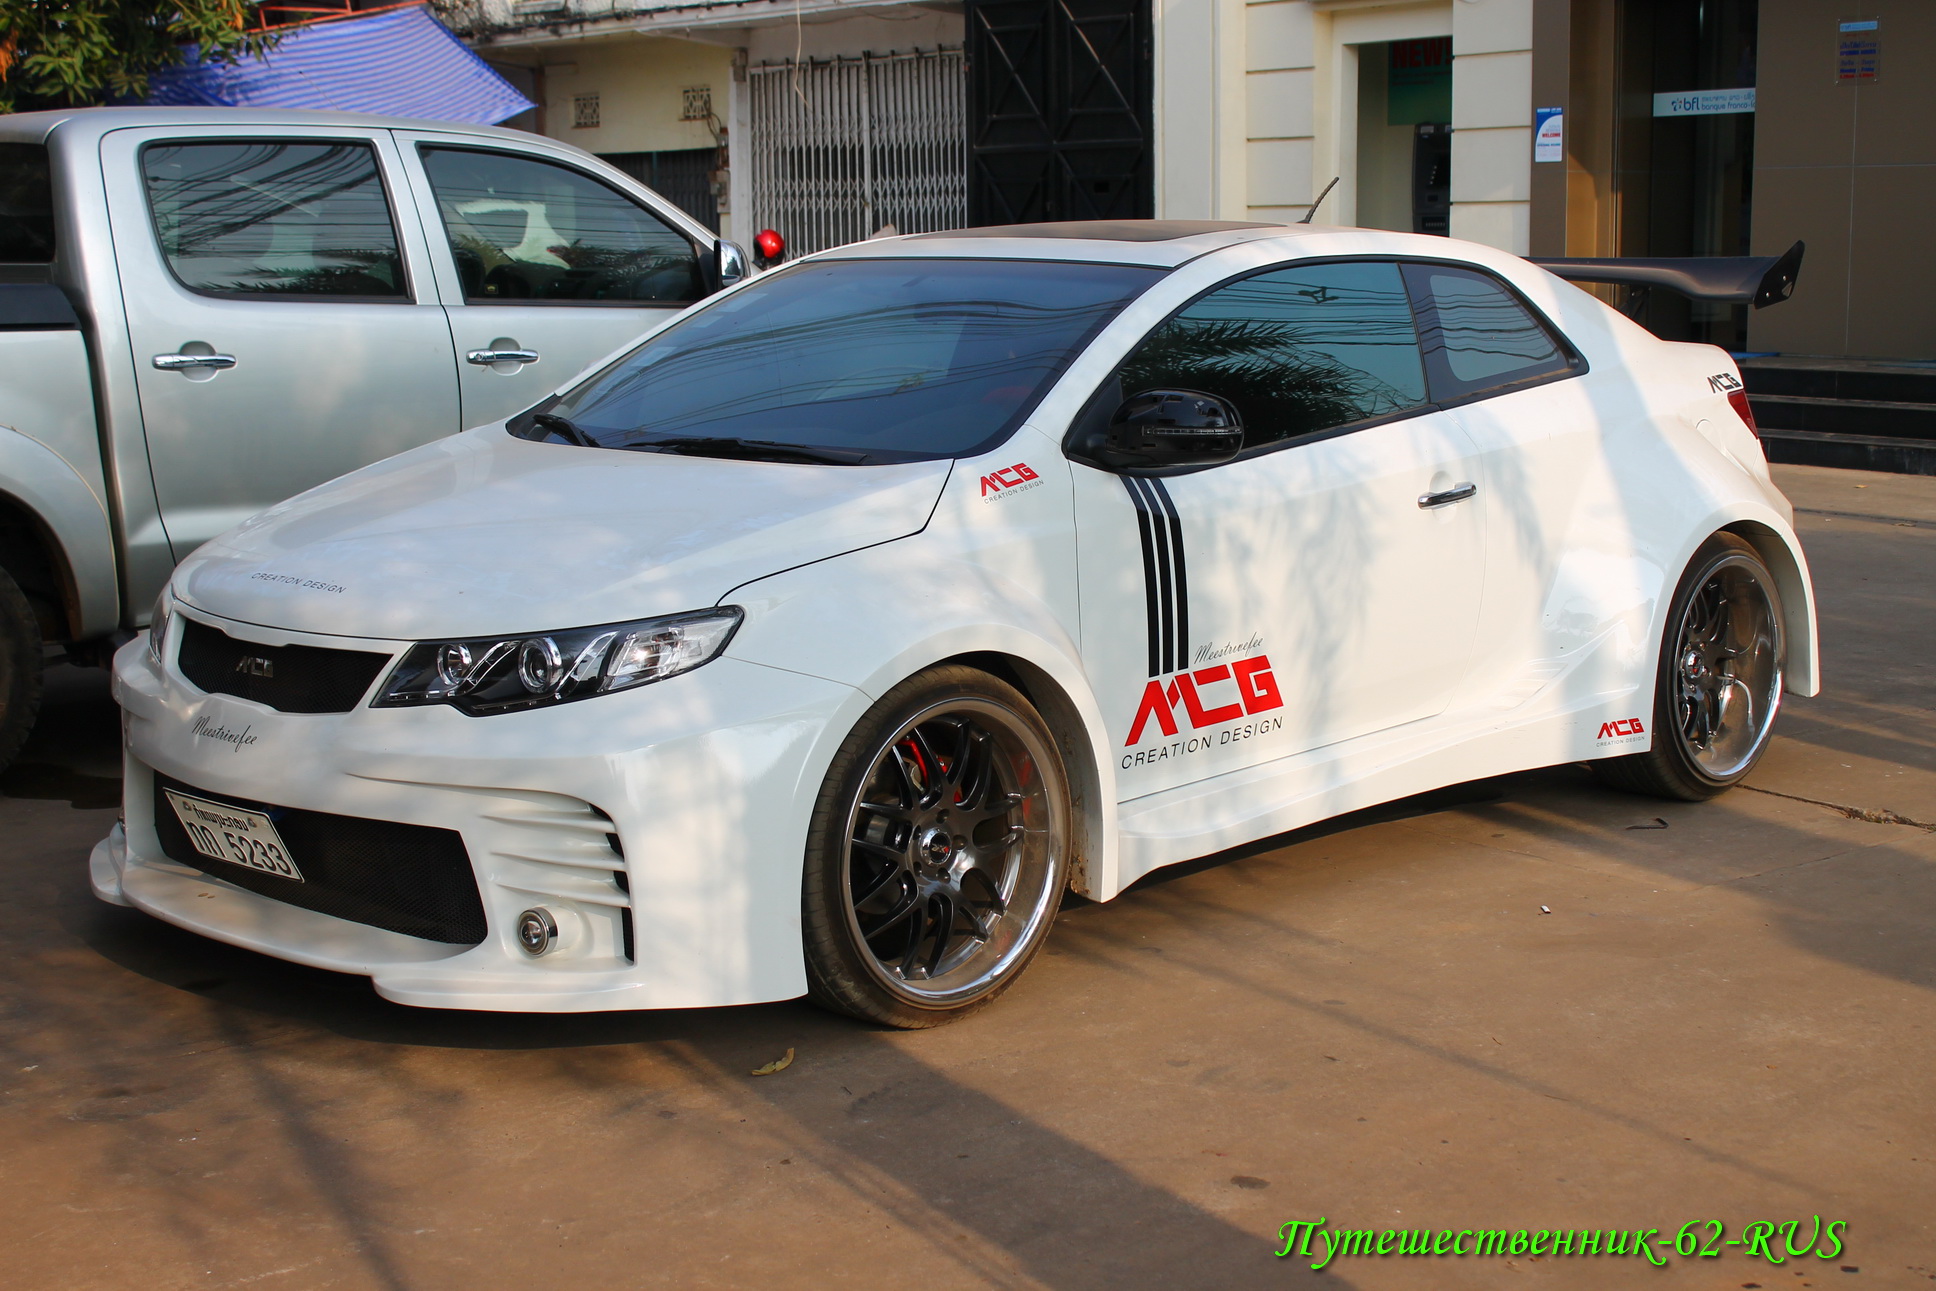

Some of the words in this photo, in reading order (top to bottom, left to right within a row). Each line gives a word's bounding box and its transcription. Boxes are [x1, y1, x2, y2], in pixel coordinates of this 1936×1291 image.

[1683, 97, 1700, 111] bfl
[1701, 102, 1726, 112] banque
[1707, 373, 1742, 393] MCG
[980, 463, 1039, 497] MCG
[984, 488, 1018, 504] CREATION
[1019, 480, 1044, 492] DESIGN
[251, 572, 302, 585] CREATION
[302, 580, 347, 594] DESIGN
[1124, 655, 1284, 747] MCG
[1597, 718, 1644, 739] MCG
[1121, 735, 1213, 770] CREATION
[1220, 716, 1284, 745] DESIGN
[1596, 739, 1624, 747] CREATION
[223, 831, 292, 875] 5233
